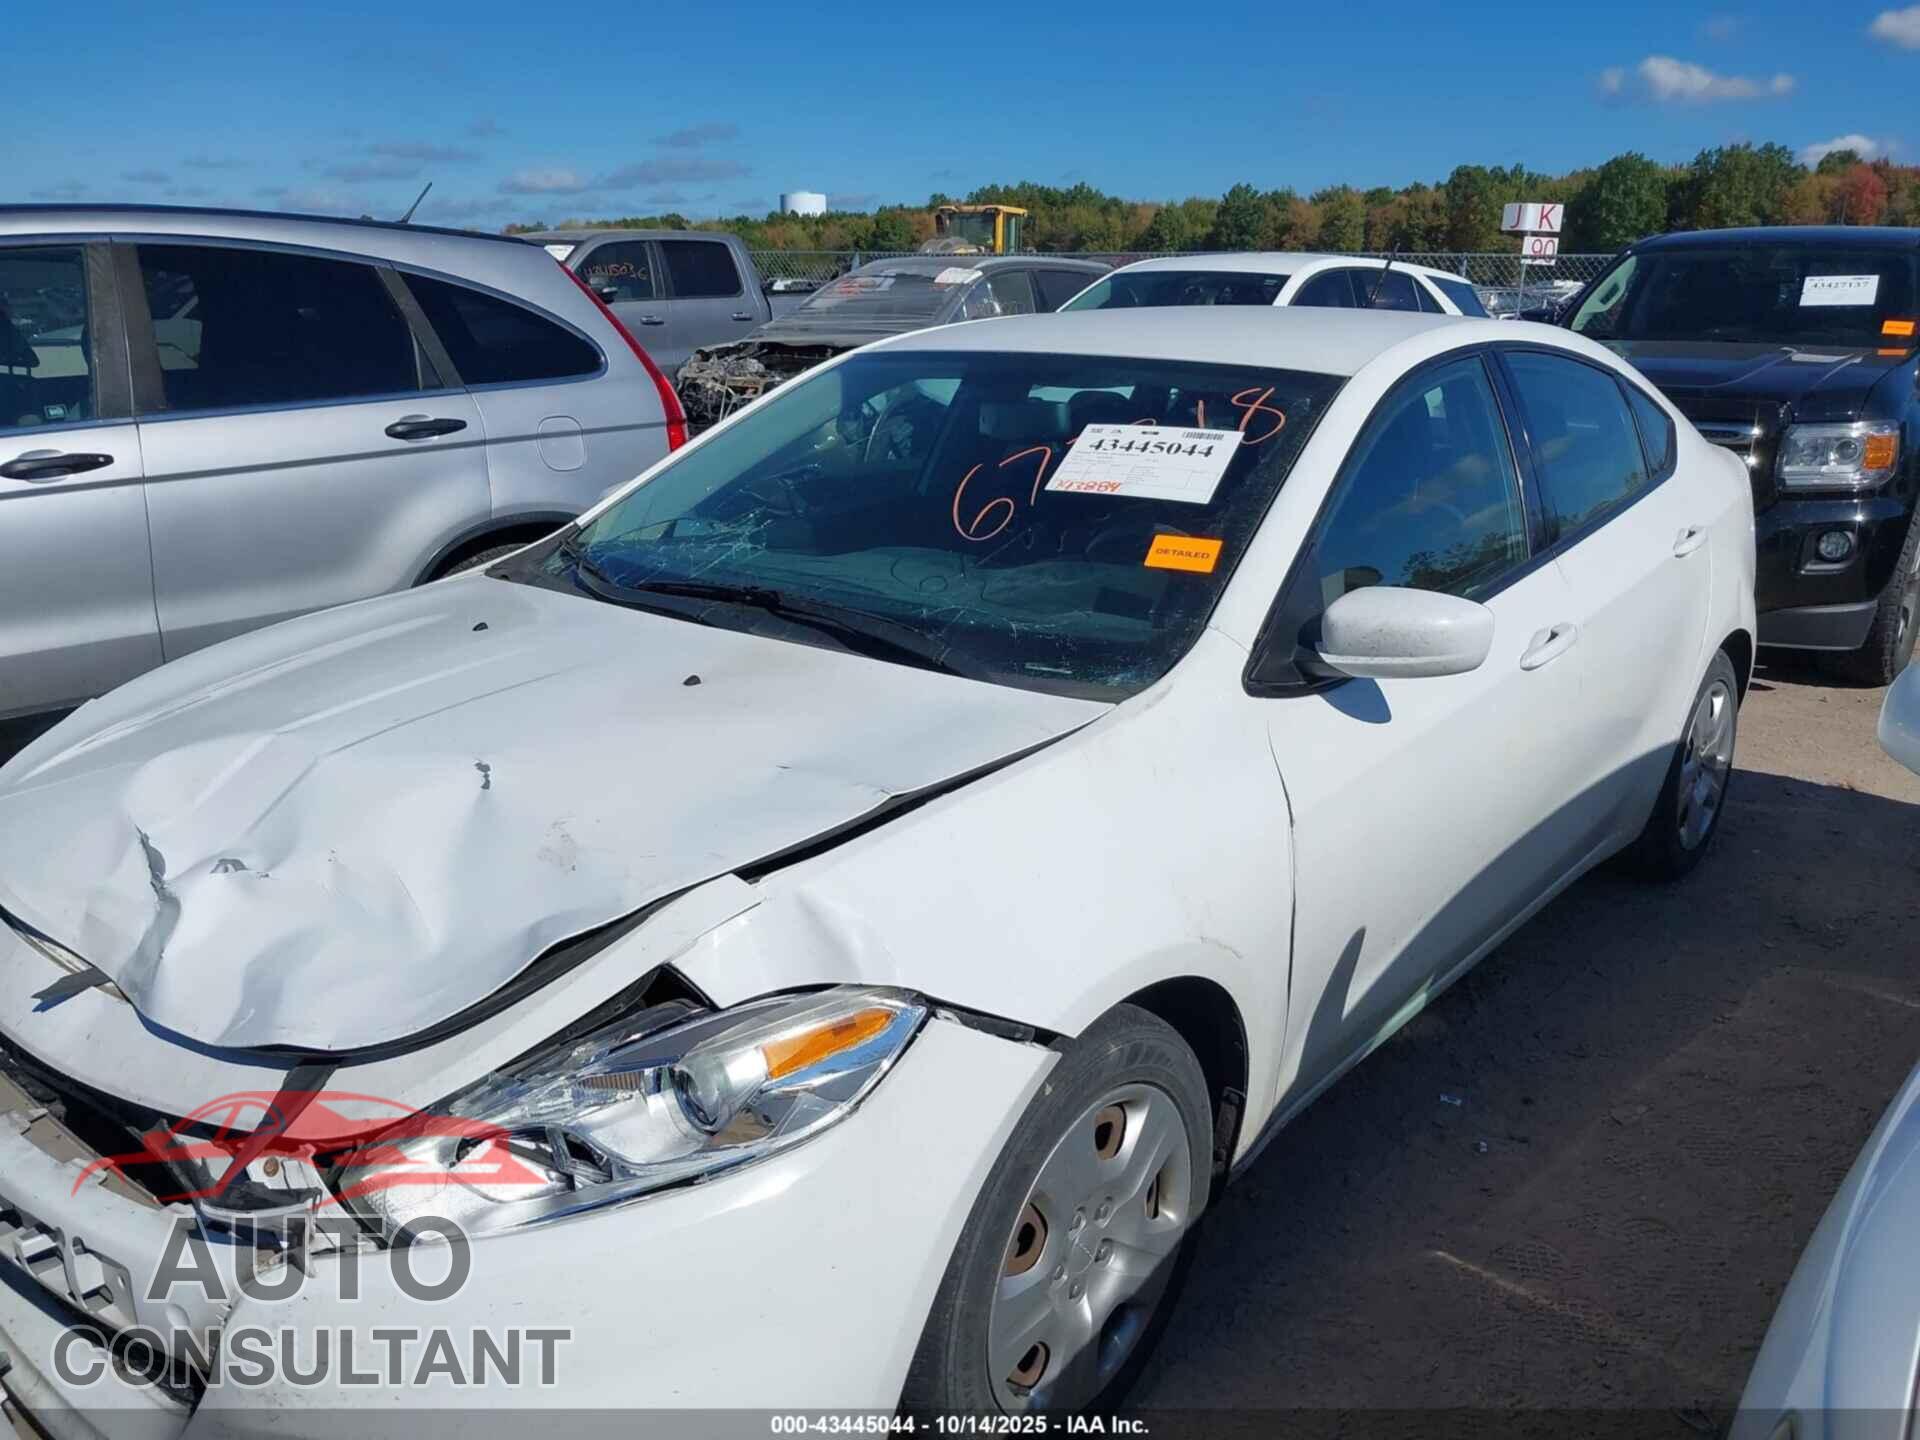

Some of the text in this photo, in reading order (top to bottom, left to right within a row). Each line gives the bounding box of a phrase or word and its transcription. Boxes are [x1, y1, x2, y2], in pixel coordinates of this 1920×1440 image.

[1509, 204, 1557, 230] J K
[1531, 238, 1556, 264] 90
[1089, 437, 1215, 459] 43445044
[1155, 547, 1211, 560] DETAILED
